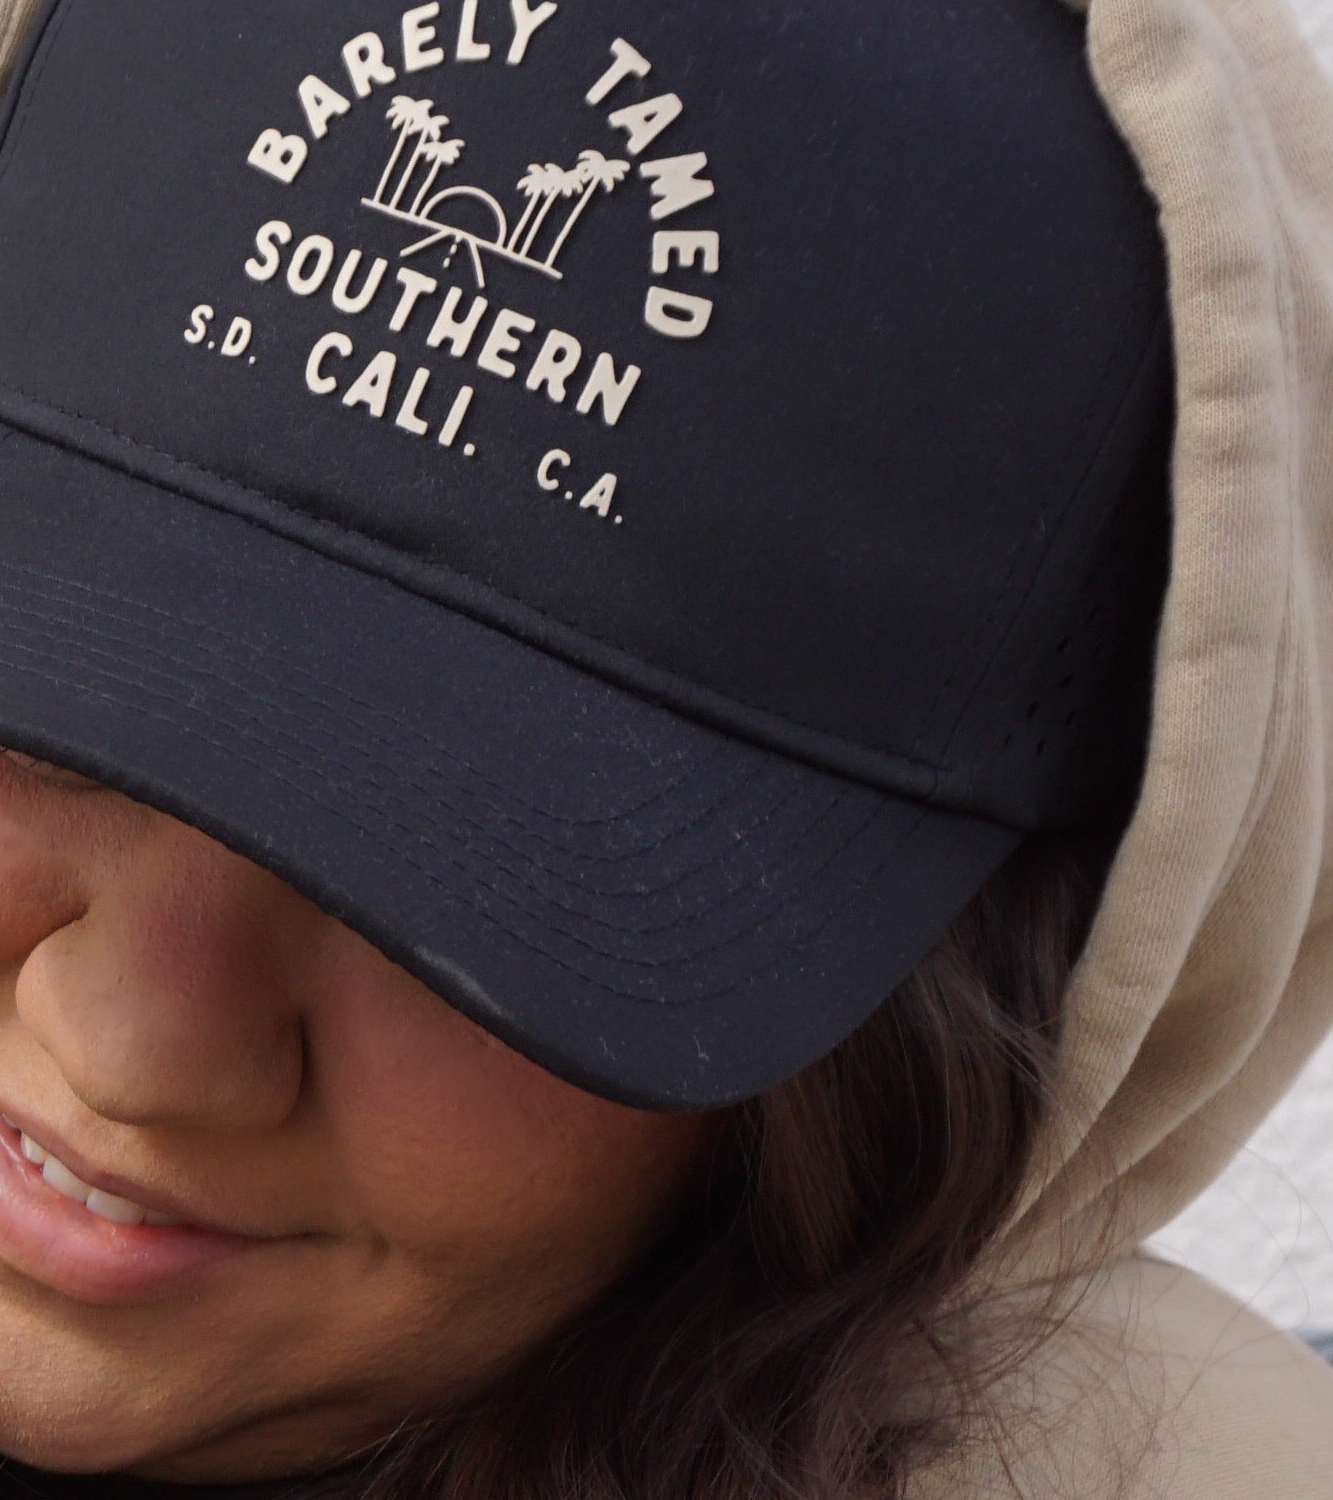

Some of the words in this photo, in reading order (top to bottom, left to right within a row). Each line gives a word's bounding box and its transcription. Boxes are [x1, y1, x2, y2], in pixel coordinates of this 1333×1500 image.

[586, 37, 719, 338] TAMED
[183, 304, 257, 365] S.D.
[305, 331, 476, 456] CALI.
[536, 448, 623, 524] C.A.
[244, 220, 641, 426] SOUTHERN
